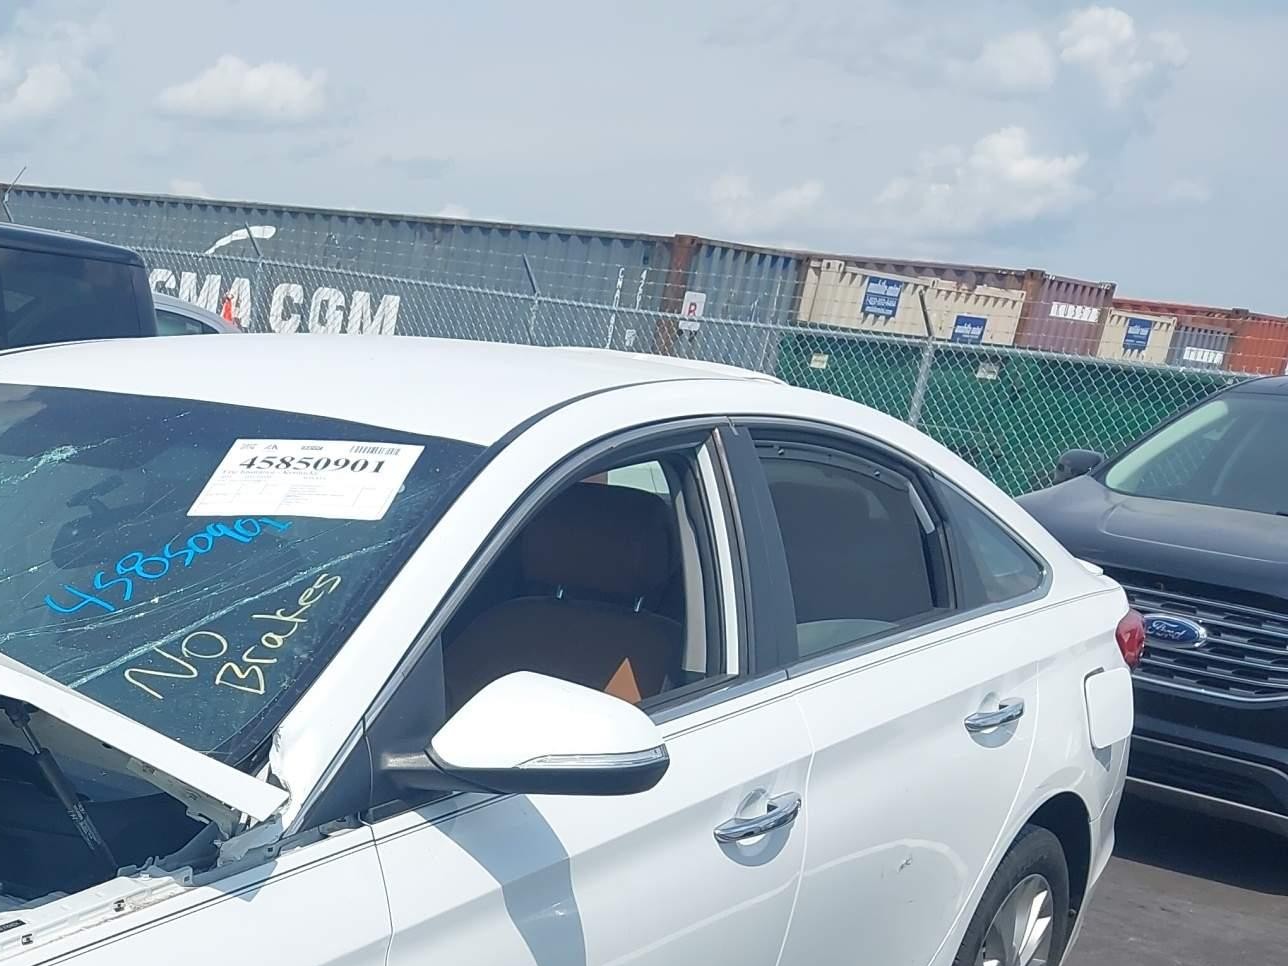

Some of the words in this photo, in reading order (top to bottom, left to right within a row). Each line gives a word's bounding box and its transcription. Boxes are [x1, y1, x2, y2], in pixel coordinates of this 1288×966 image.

[269, 283, 401, 335] CGM
[239, 456, 387, 474] 45850901
[43, 516, 294, 614] 45850901
[214, 573, 342, 695] Brakes
[1152, 620, 1188, 639] Ford
